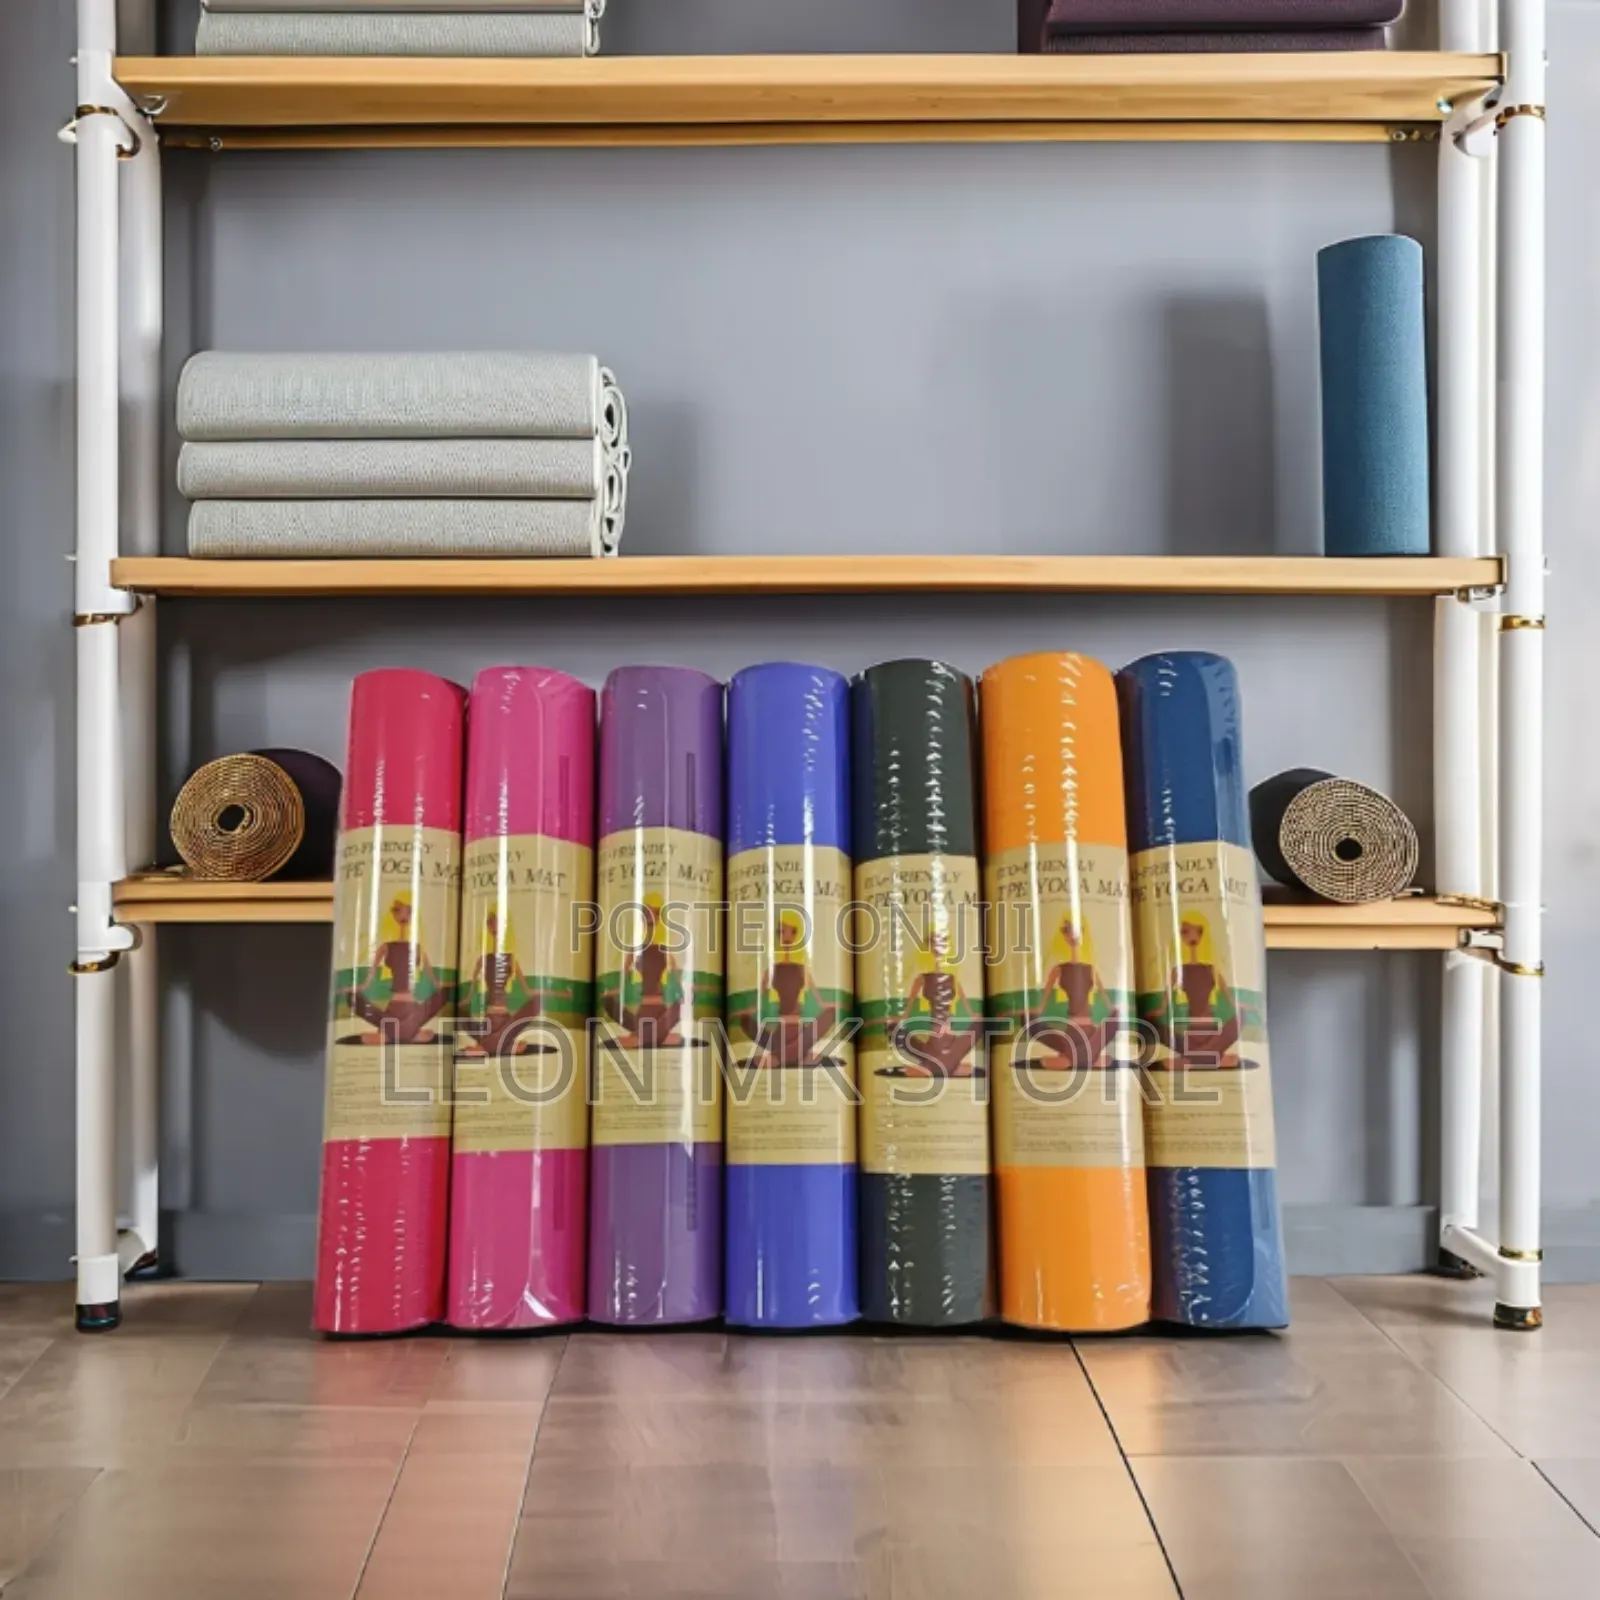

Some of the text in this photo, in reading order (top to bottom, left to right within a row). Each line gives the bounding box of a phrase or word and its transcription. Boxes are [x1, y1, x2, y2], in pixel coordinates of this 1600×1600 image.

[372, 858, 425, 876] OGA
[620, 861, 667, 880] YGA
[526, 868, 566, 887] MAT
[902, 888, 954, 904] YOA
